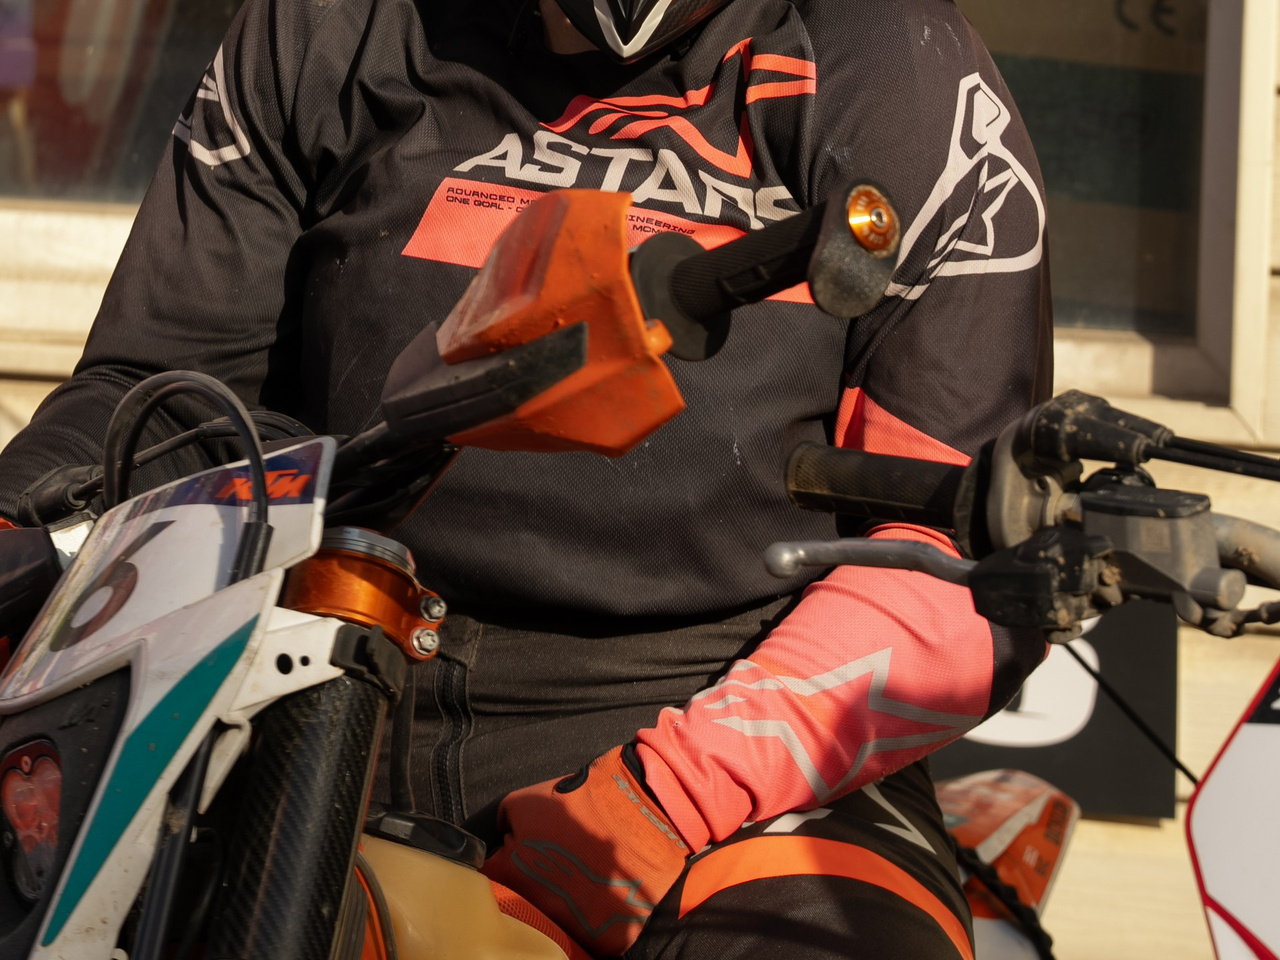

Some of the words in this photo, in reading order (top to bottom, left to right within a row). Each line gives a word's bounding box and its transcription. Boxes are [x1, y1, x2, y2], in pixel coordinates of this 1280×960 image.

[445, 195, 470, 205] ONE
[473, 199, 504, 211] GOAL
[625, 213, 696, 235] INEERING
[214, 468, 312, 500] KTM
